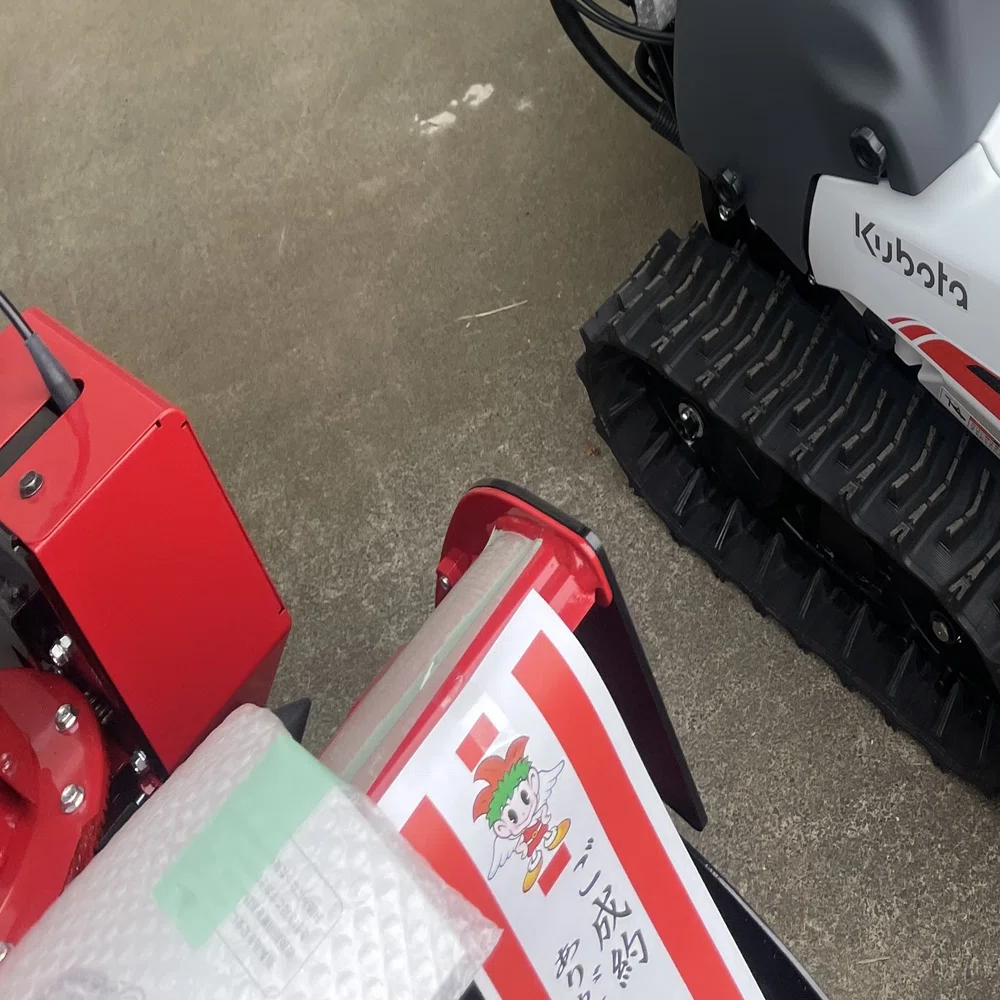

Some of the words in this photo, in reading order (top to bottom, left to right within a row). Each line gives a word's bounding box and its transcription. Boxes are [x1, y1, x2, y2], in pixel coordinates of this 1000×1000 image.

[854, 212, 968, 311] Kubota
[573, 837, 649, 989] ご成約
